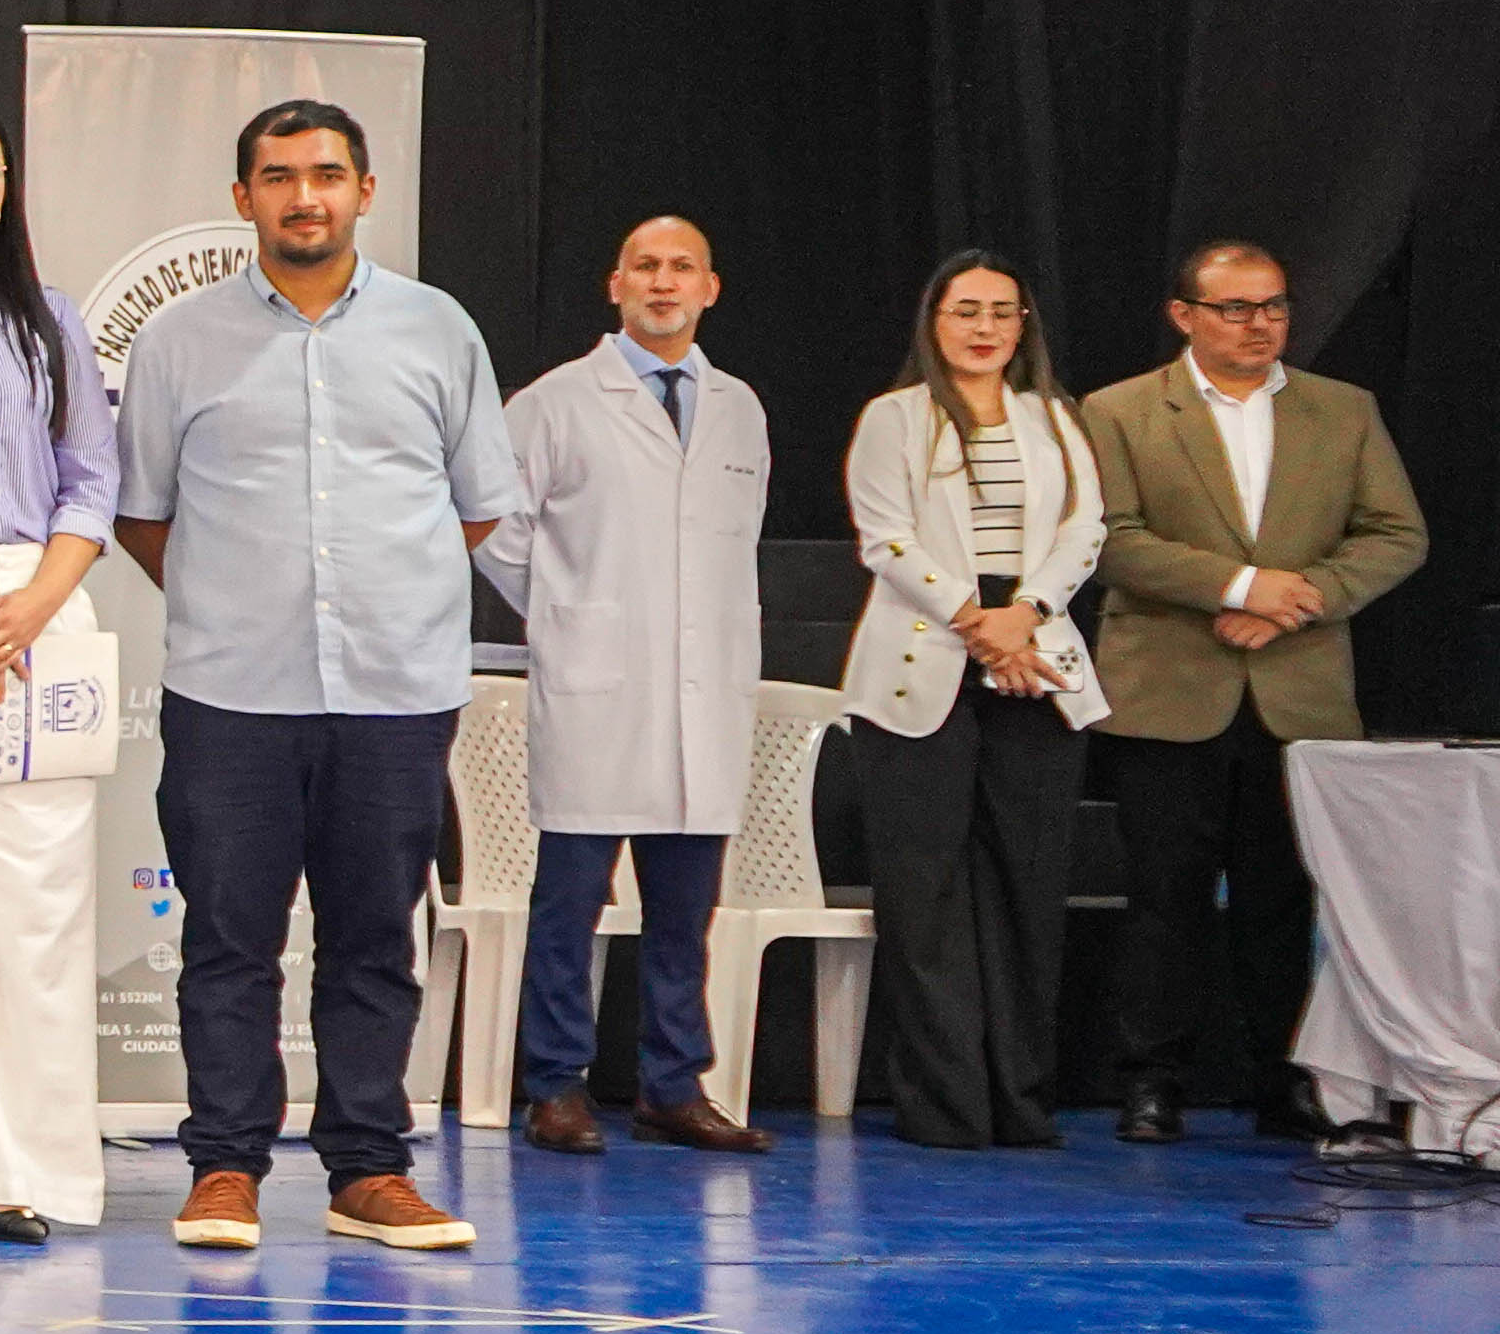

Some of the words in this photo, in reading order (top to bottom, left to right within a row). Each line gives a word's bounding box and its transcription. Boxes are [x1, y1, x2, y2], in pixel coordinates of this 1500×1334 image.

[93, 274, 165, 363] FACULTAD
[158, 258, 189, 297] DE
[144, 1024, 181, 1036] AVEN
[121, 1040, 180, 1053] CIUDAD
